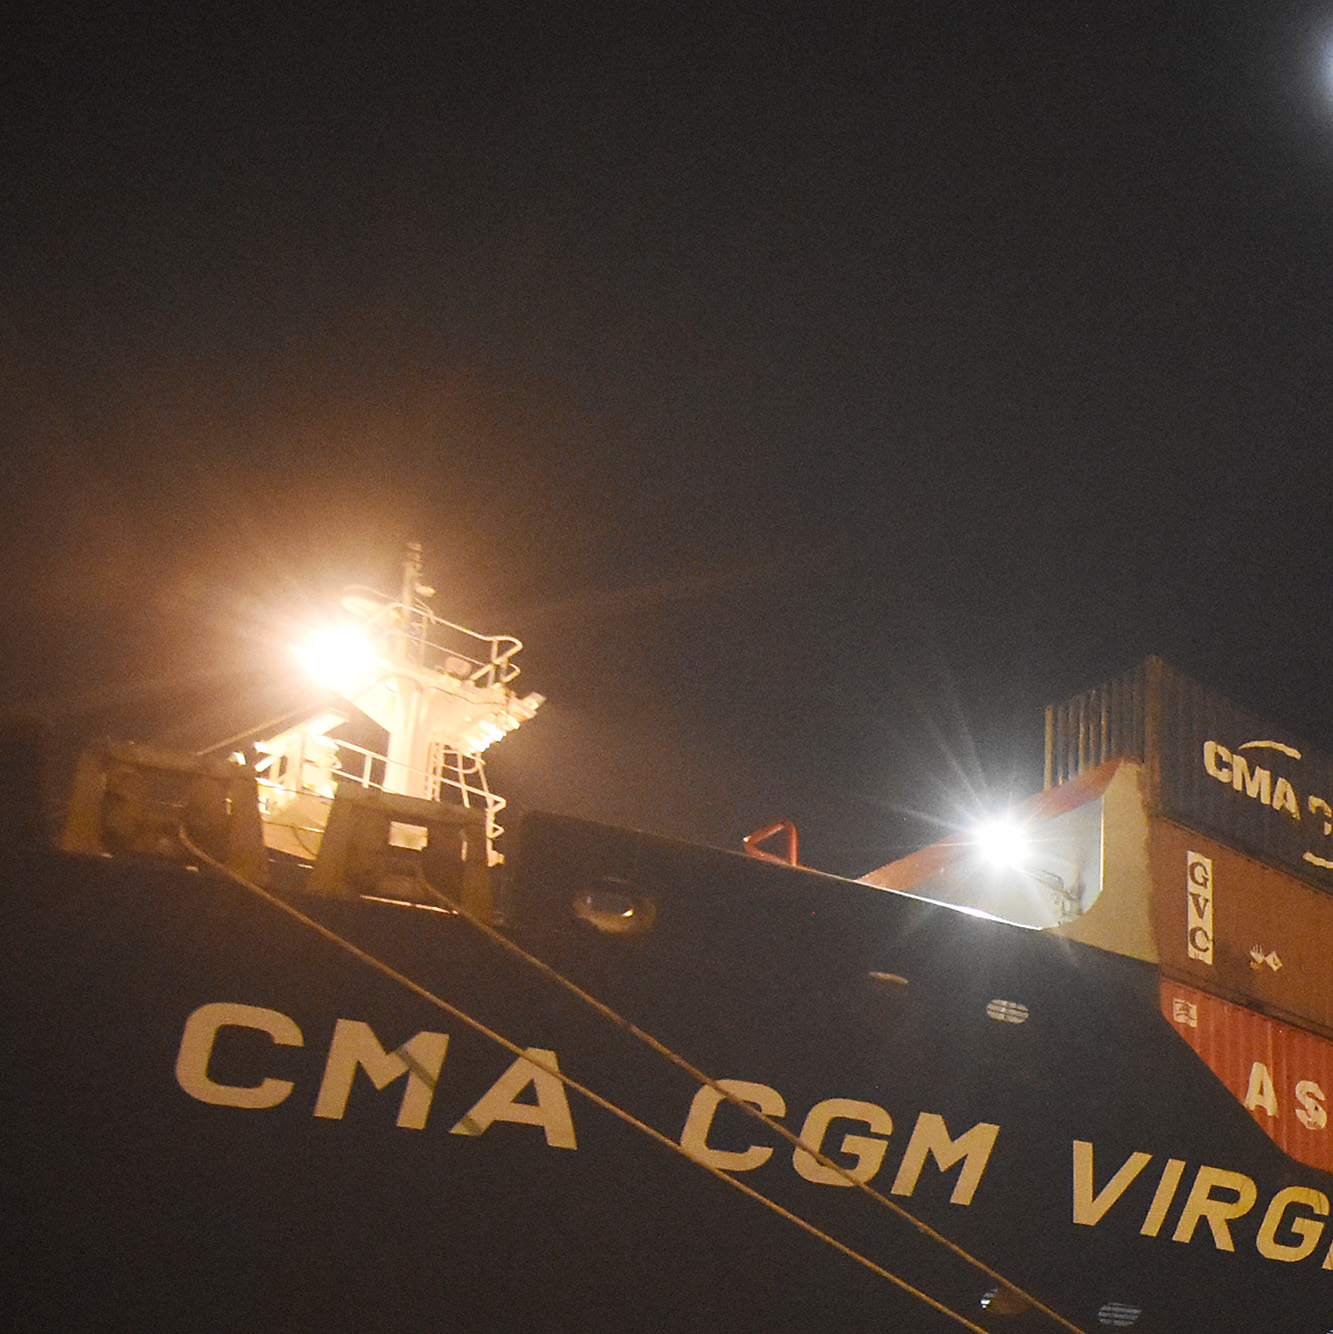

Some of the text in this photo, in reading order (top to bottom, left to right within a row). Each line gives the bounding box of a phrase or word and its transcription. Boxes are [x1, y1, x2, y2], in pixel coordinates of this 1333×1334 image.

[1203, 740, 1300, 820] CMA
[1189, 861, 1211, 953] GVC
[175, 1002, 577, 1150] CMA
[680, 1079, 1000, 1205] CGM
